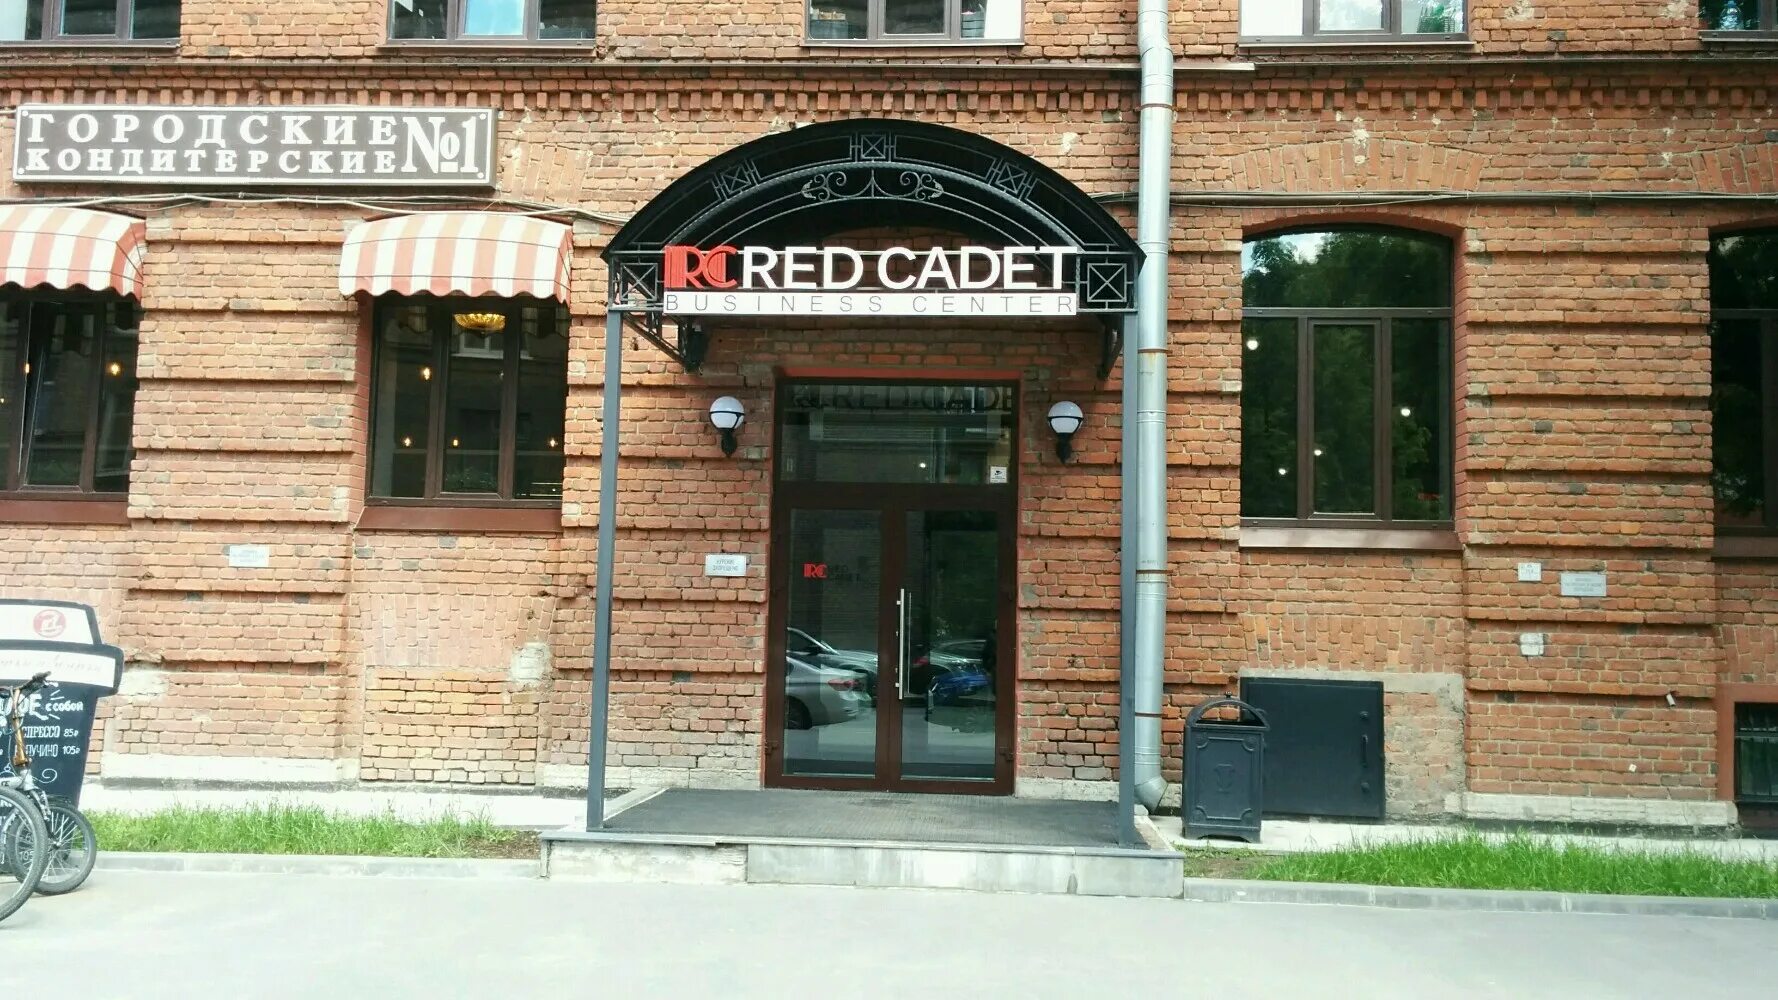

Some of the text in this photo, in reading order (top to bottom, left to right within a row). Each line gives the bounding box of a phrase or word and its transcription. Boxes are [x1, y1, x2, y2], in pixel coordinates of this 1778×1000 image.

[27, 113, 398, 150] ГОРОДСКИЕ
[25, 148, 397, 175] КОНДИТЕРСКИЕ
[743, 246, 863, 290] RED
[877, 246, 1078, 290] CADET
[666, 294, 1073, 314] BUSINESS CENTER
[52, 700, 84, 712] собой
[22, 725, 61, 738] СПРЕССО
